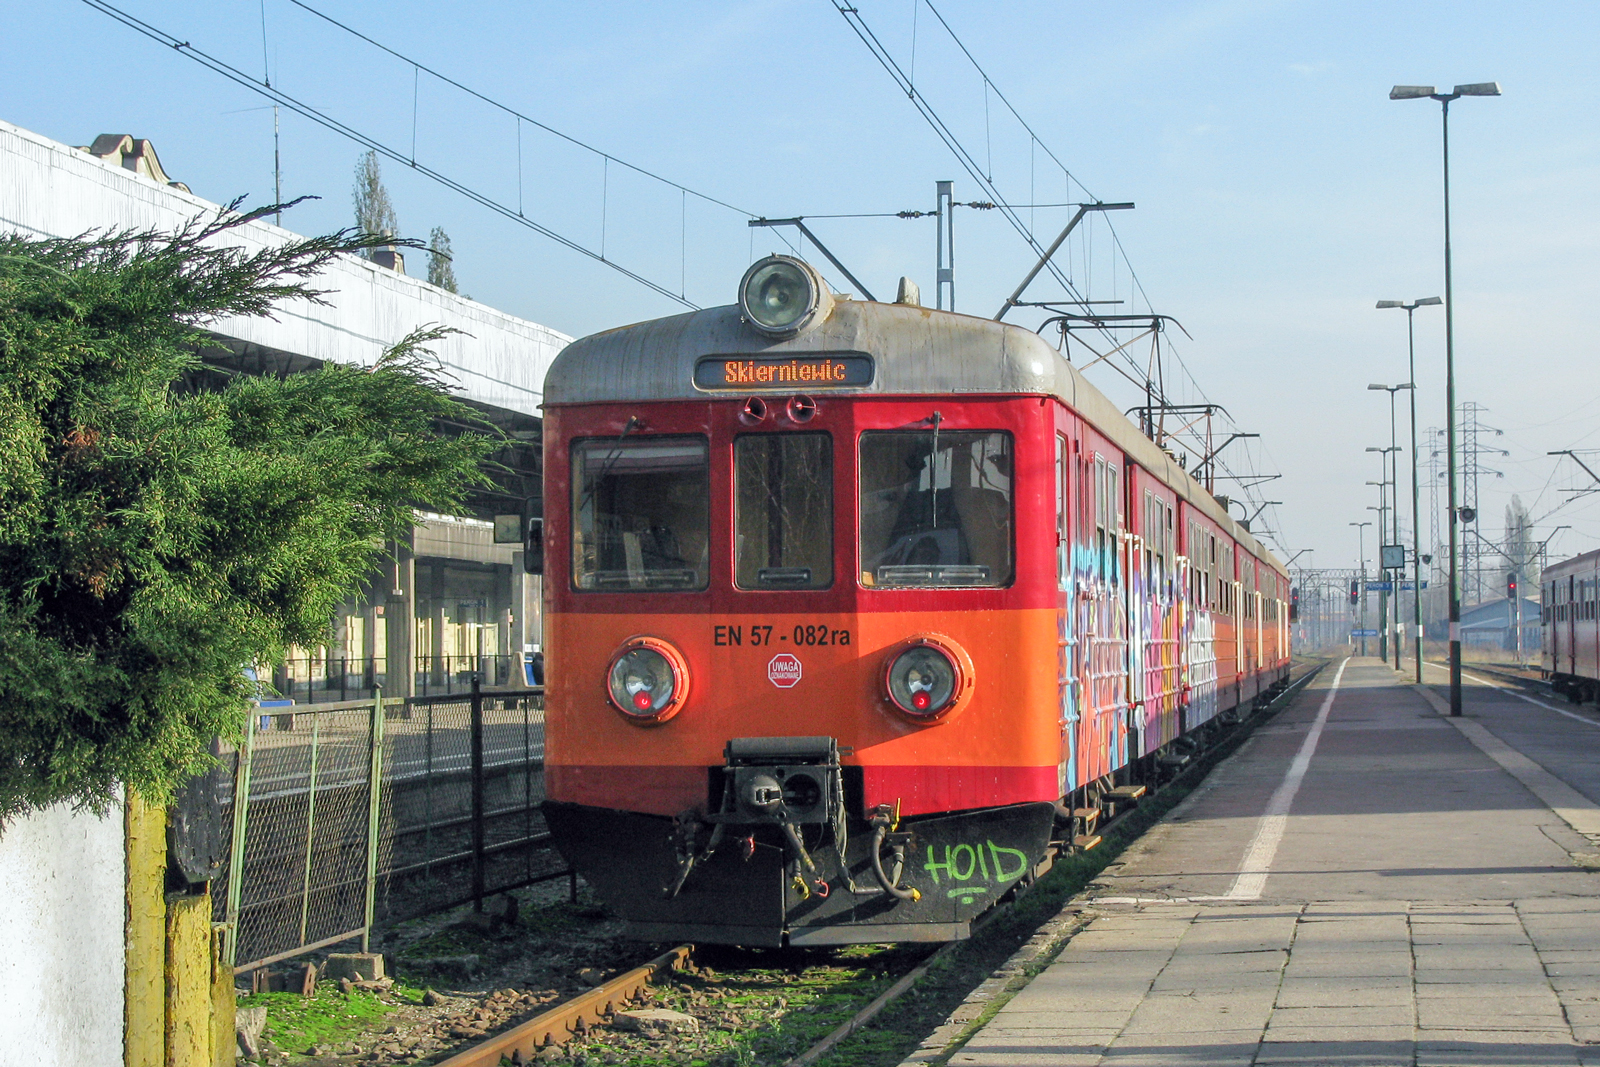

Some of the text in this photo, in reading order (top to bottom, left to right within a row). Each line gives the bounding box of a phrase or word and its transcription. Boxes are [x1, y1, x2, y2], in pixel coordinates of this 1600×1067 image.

[725, 359, 846, 383] Skierniewic
[714, 625, 742, 646] EN
[751, 625, 773, 646] 57
[772, 661, 798, 671] UWAGA
